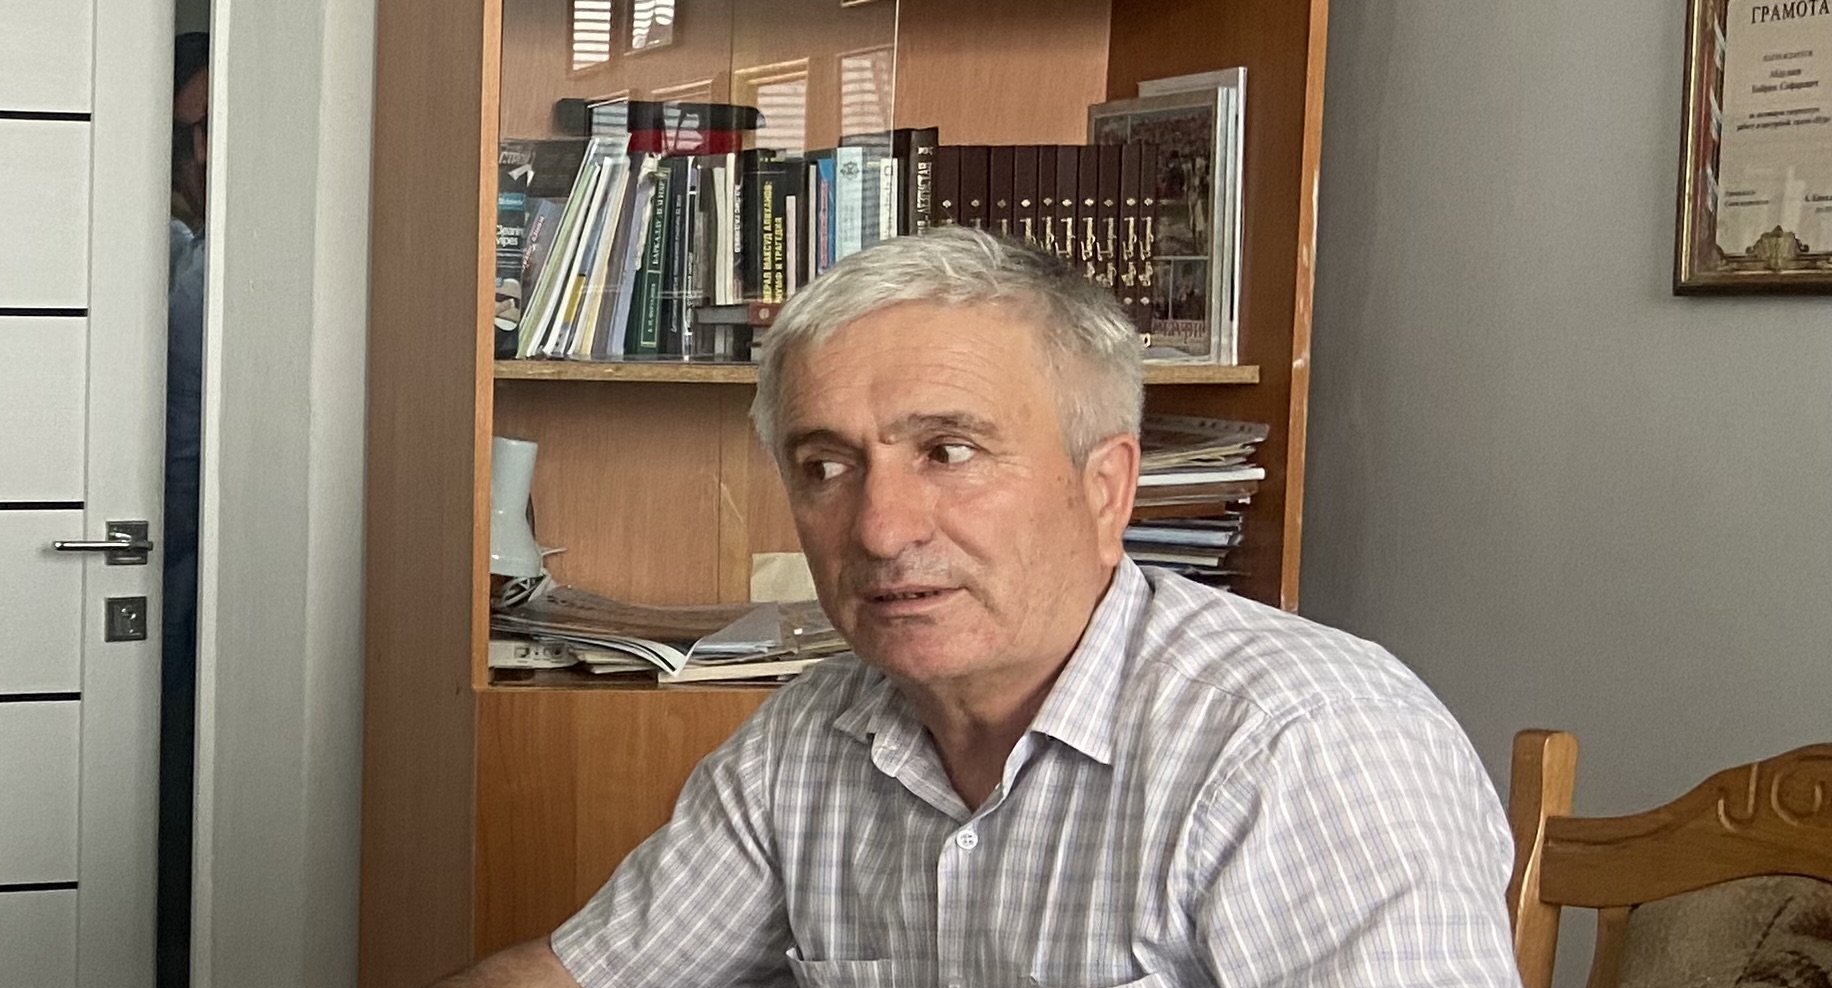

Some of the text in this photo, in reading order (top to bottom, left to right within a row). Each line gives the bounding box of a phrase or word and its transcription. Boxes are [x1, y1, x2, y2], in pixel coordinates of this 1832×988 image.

[1750, 0, 1830, 25] ГРАМОТА
[763, 233, 772, 270] МАКСУД
[774, 216, 784, 261] ТРАГЕДИЯ
